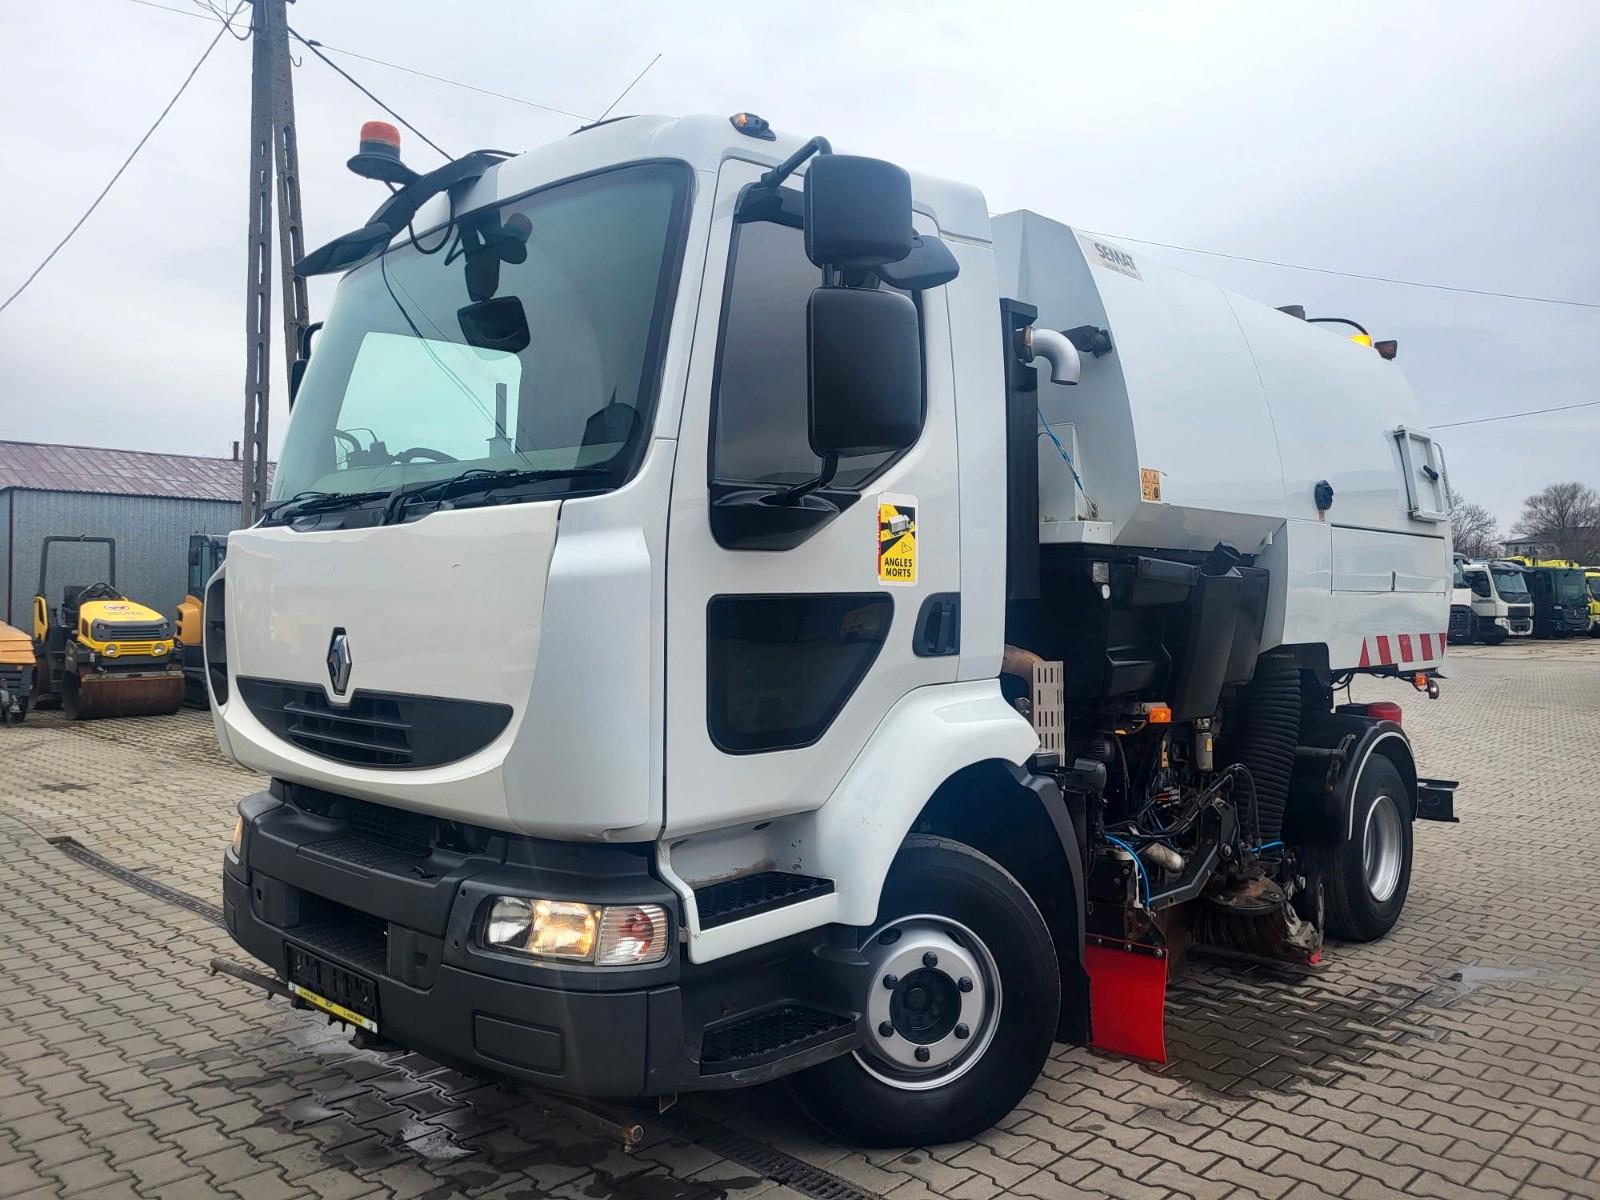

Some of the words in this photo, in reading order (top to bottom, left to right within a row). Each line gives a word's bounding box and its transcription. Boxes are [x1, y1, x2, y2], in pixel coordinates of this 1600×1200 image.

[1094, 242, 1137, 271] SEMAT
[884, 557, 913, 567] ANGLES
[885, 568, 912, 578] MORTS
